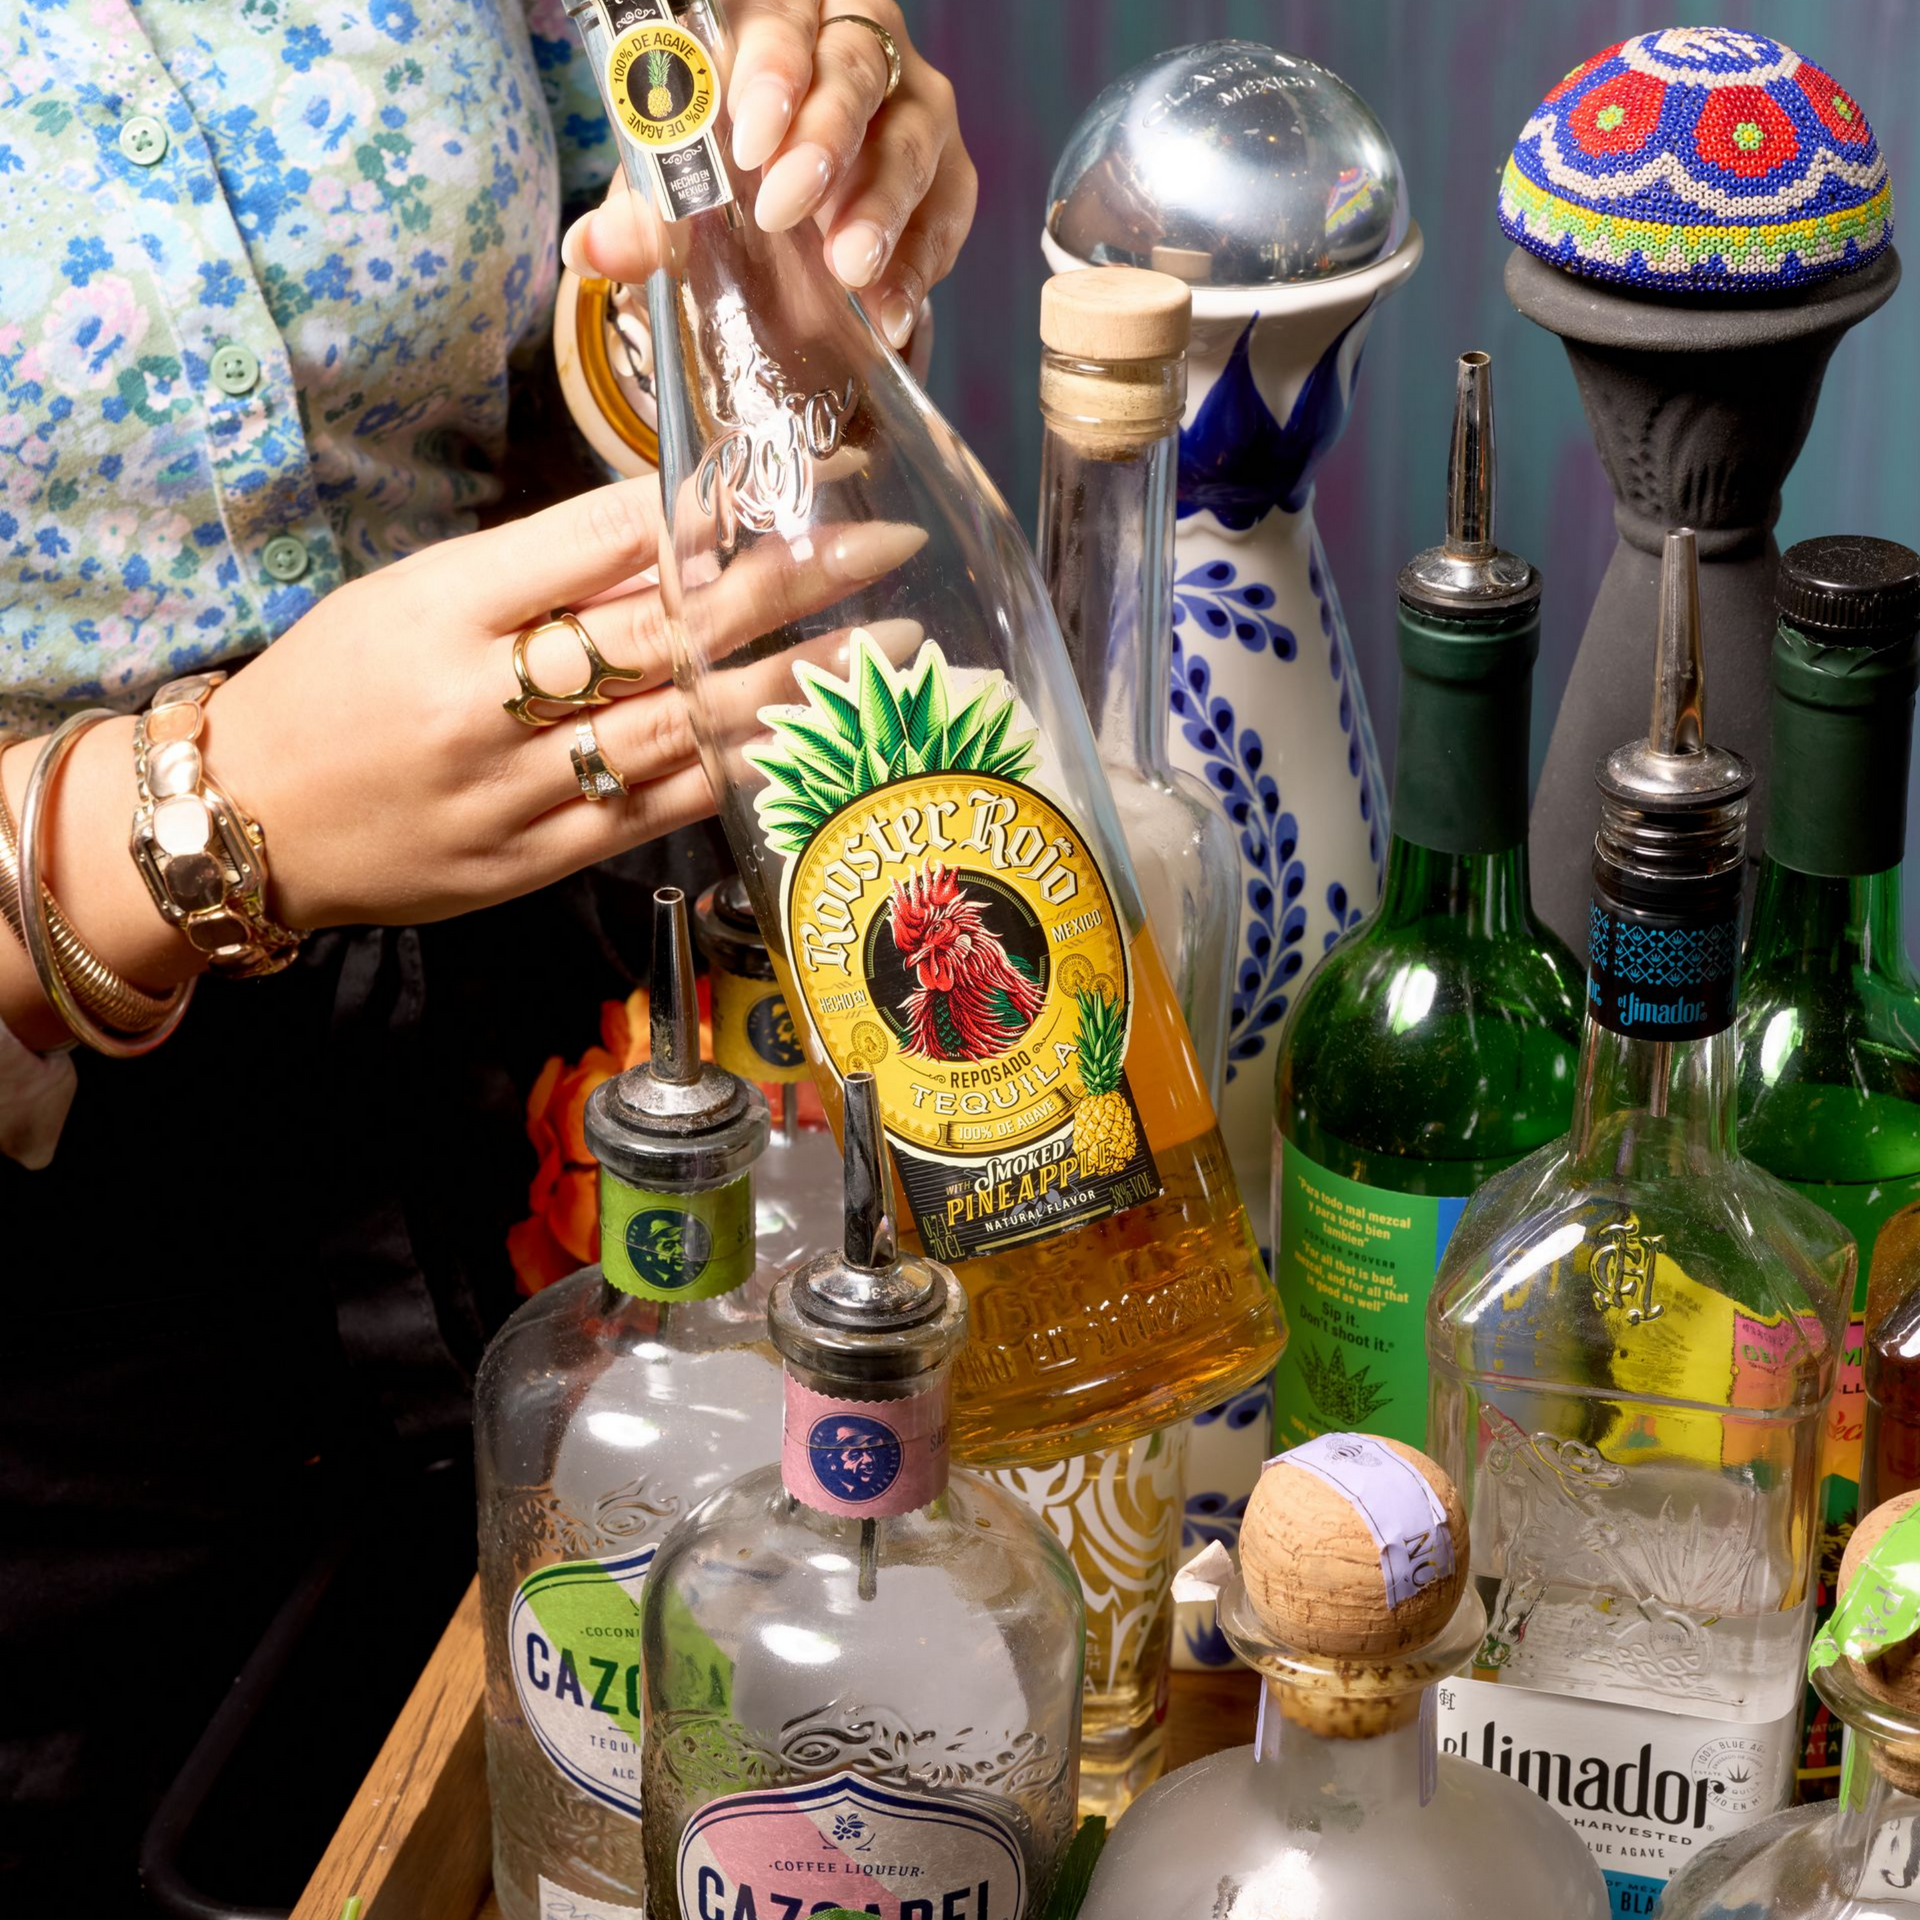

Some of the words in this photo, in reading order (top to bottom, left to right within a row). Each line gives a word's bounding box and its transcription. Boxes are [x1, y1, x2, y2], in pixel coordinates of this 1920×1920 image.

[614, 48, 633, 84] 100%
[631, 32, 651, 52] DE
[653, 32, 697, 60] AGAVE
[685, 88, 710, 124] 100%
[627, 112, 664, 139] AGAVE
[668, 120, 686, 138] DE
[670, 173, 701, 192] HECHO
[700, 169, 710, 179] EN
[678, 182, 710, 200] MEXICO
[799, 800, 960, 976] Rooster
[960, 788, 1079, 907] Rojo
[1050, 908, 1103, 944] MEXICO
[819, 991, 854, 1015] HECHO
[853, 989, 867, 1006] EN
[1620, 992, 1706, 1026] Jimador
[910, 1042, 1080, 1116] TEQUILA
[950, 1050, 1031, 1089] REPOSADO
[958, 1123, 994, 1140] 100%
[996, 1120, 1015, 1135] DE
[1016, 1101, 1057, 1130] AGAVE
[945, 1180, 971, 1196] WITH
[946, 1138, 1115, 1227] PINEAPPLE
[984, 1208, 1044, 1233] NATURAL
[1046, 1190, 1096, 1214] FLAVOR
[1315, 1205, 1336, 1223] para
[1338, 1215, 1362, 1232] todo
[1365, 1223, 1391, 1240] bien
[1321, 1192, 1343, 1211] todo
[1346, 1205, 1366, 1219] mal
[1368, 1212, 1411, 1229] mezcal
[930, 1238, 947, 1261] 70
[945, 1234, 966, 1259] CL
[1304, 1227, 1342, 1253] POPULAR
[1348, 1249, 1396, 1269] PROVERB
[1321, 1254, 1333, 1266] all
[1335, 1260, 1356, 1276] that
[1359, 1267, 1369, 1280] is
[1372, 1271, 1397, 1289] bad,
[1316, 1281, 1340, 1299] good
[1342, 1293, 1354, 1304] as
[1327, 1272, 1346, 1286] and
[1348, 1278, 1364, 1293] for
[1367, 1286, 1381, 1298] all
[1384, 1289, 1409, 1303] that
[1300, 1304, 1328, 1332] Don't
[1332, 1324, 1370, 1349] shoot
[1322, 1301, 1342, 1322] Sip
[1346, 1311, 1360, 1329] it.
[586, 1626, 640, 1638] COCON
[1697, 1746, 1717, 1765] 100%
[1718, 1741, 1746, 1750] BLUE
[612, 1767, 638, 1781] ALC.
[1732, 1802, 1747, 1811] EN
[1621, 1846, 1665, 1858] AGAVE
[775, 1860, 838, 1873] COFFEE
[845, 1862, 920, 1877] LIQUEUR
